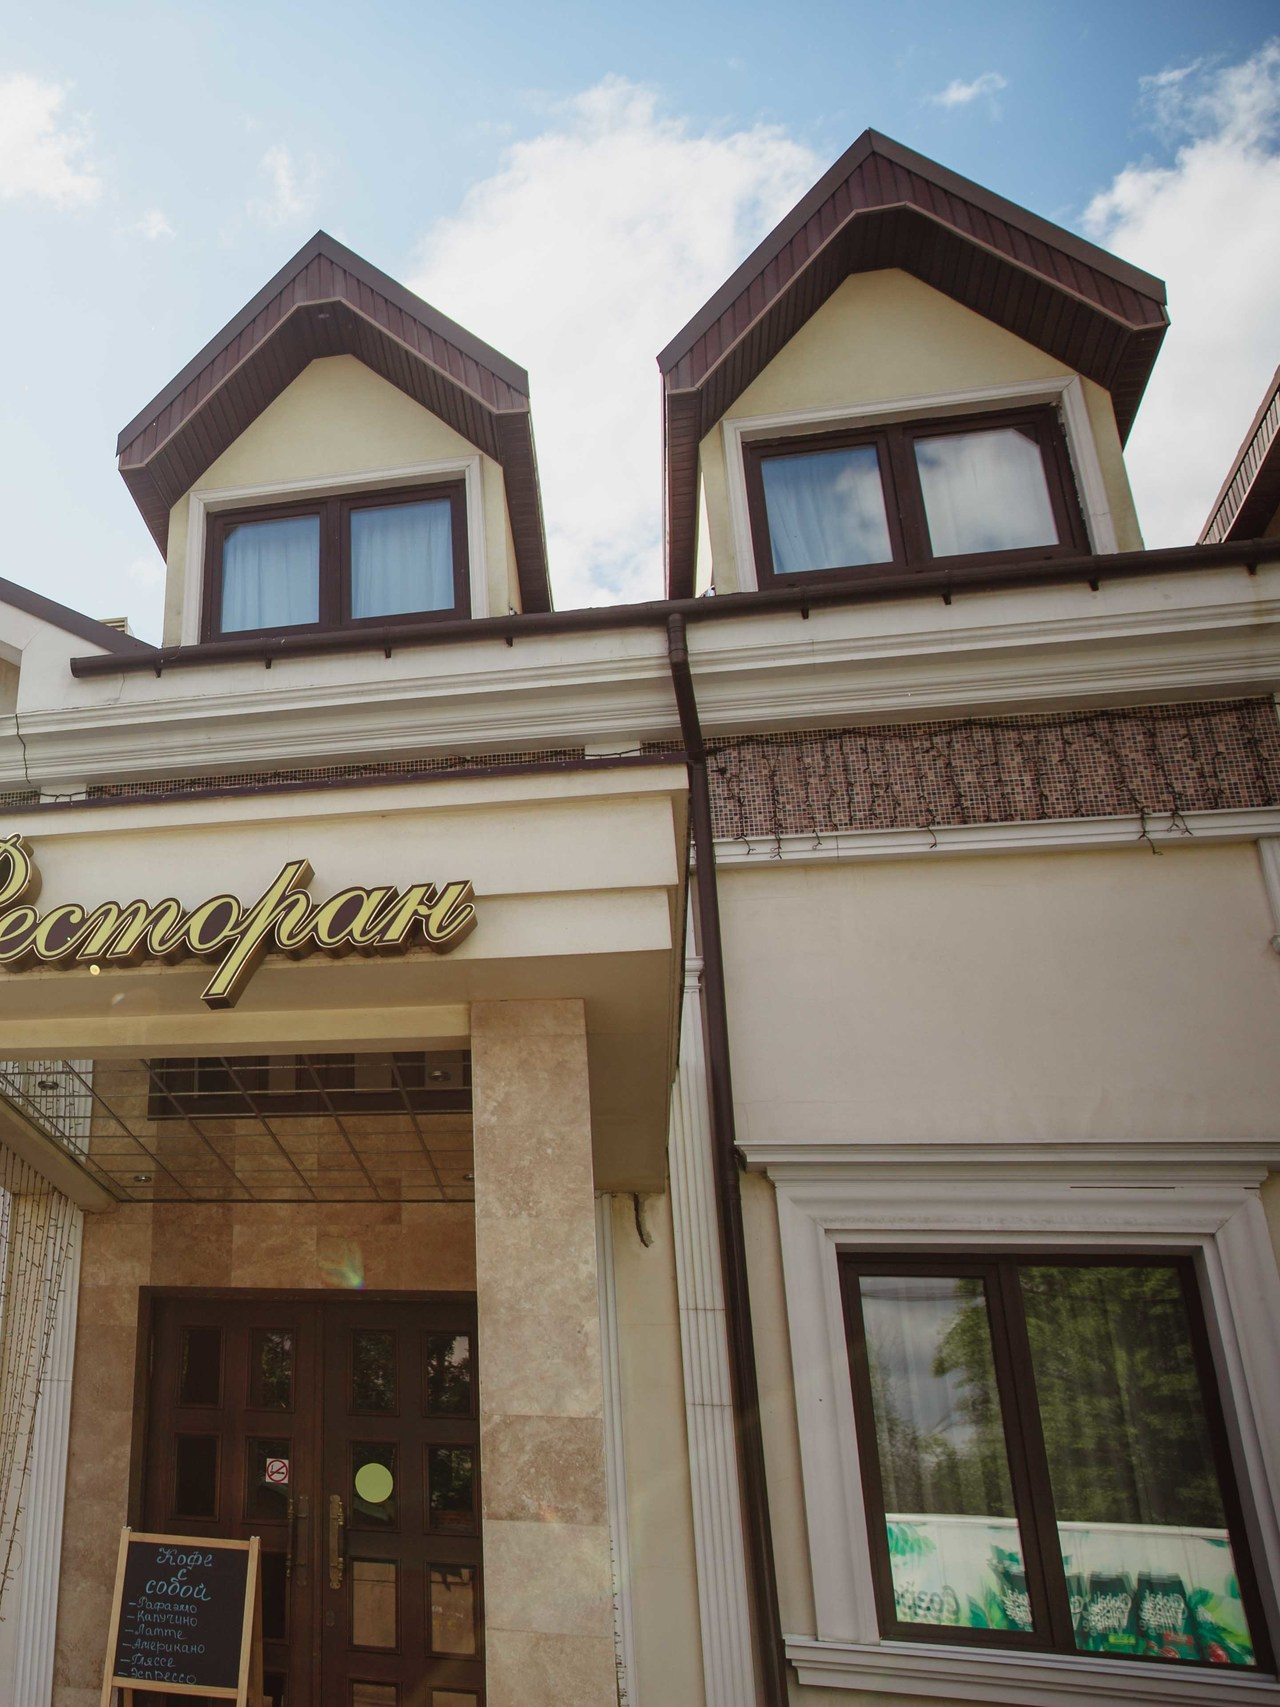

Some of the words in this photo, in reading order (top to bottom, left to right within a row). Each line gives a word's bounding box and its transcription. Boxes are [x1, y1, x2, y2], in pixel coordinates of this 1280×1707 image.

[156, 1547, 213, 1570] Кофе
[177, 1569, 188, 1581] с
[145, 1577, 211, 1601] собой
